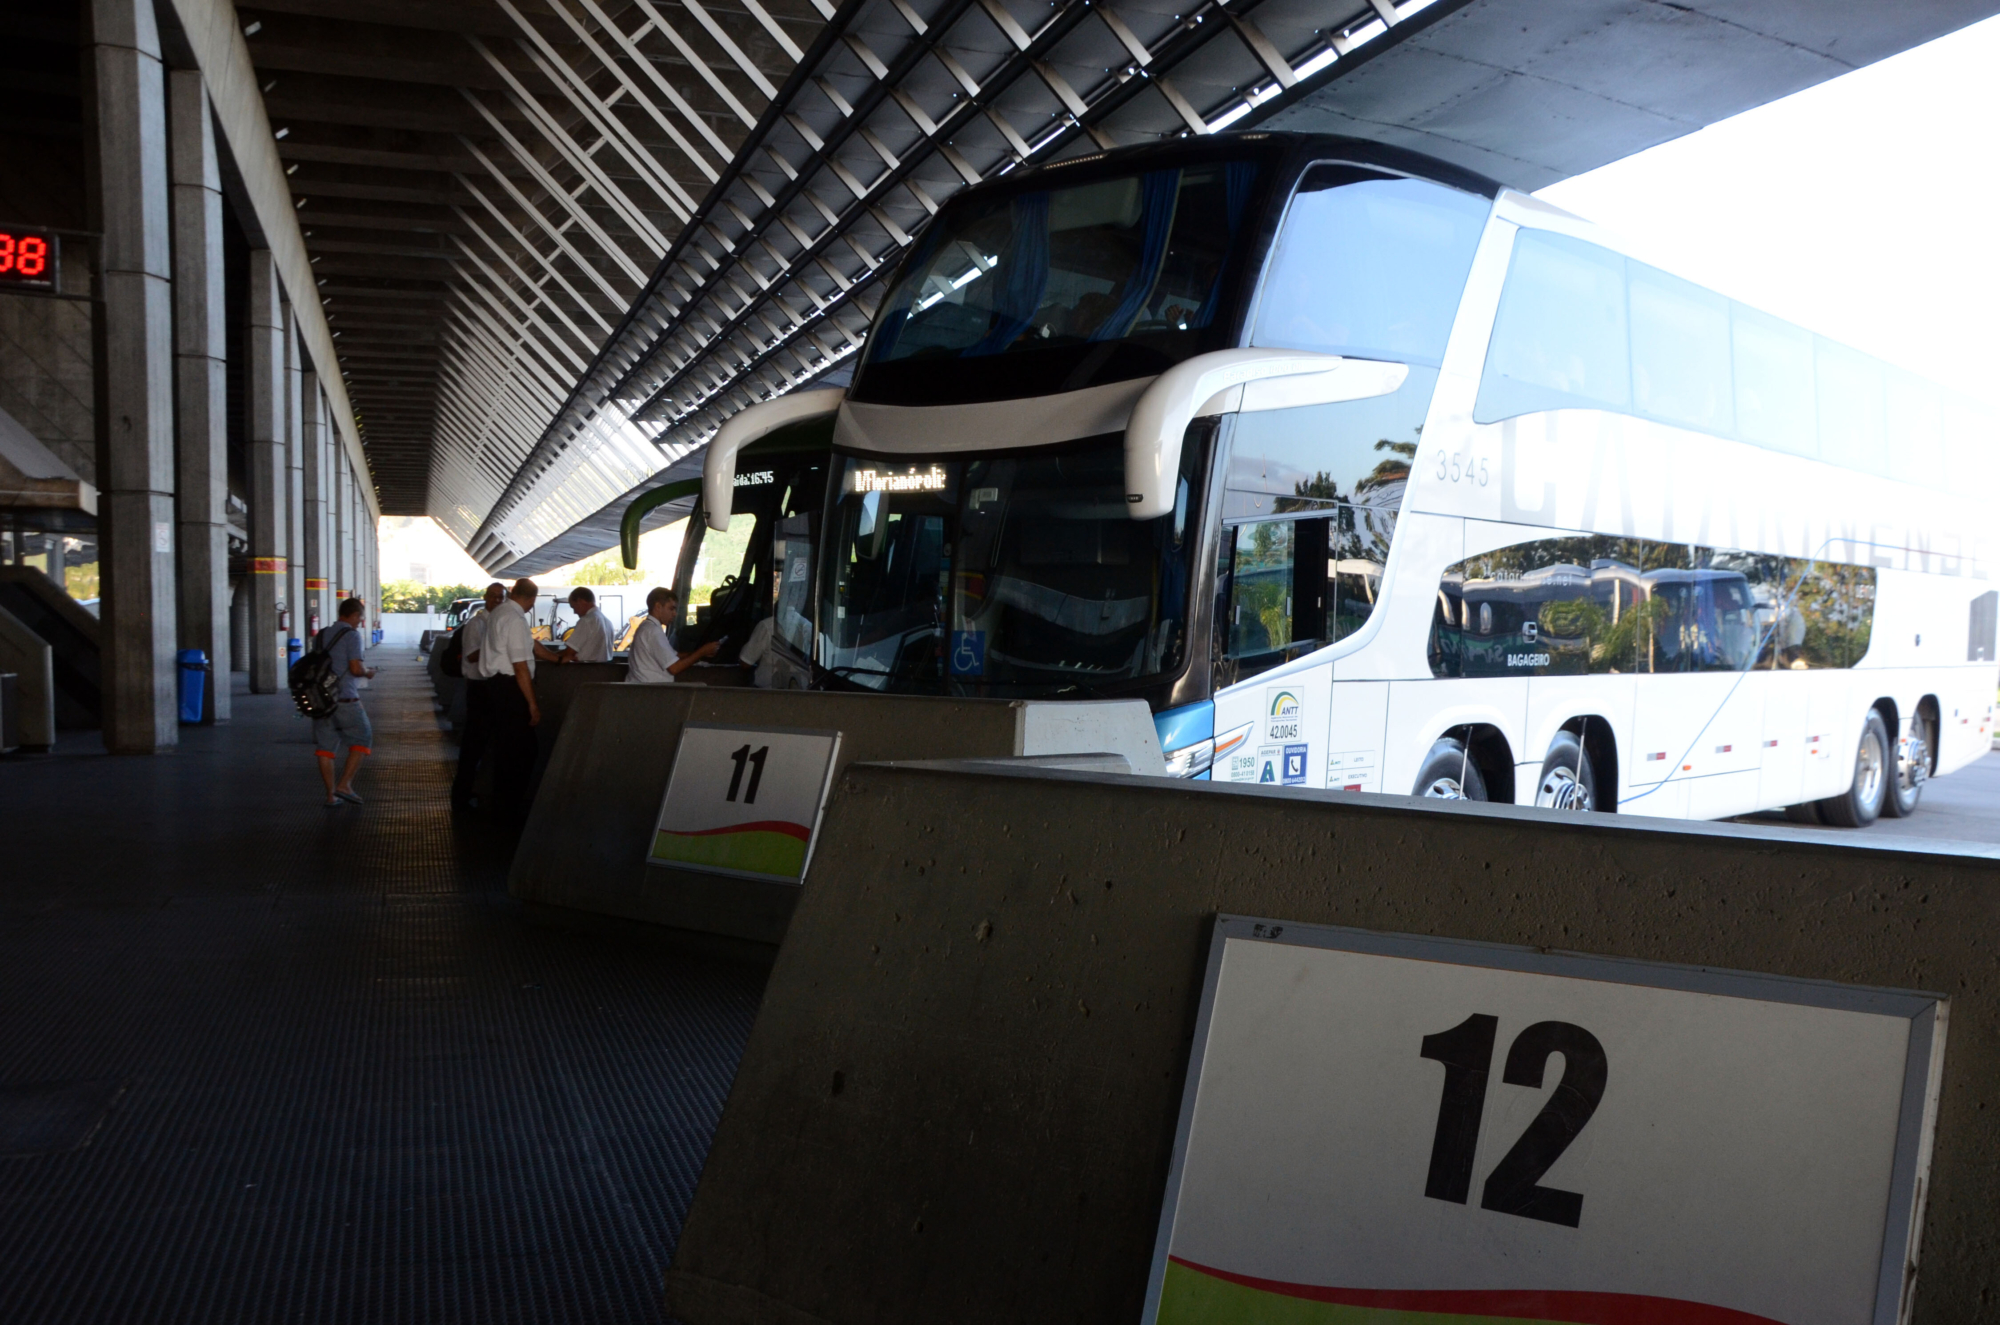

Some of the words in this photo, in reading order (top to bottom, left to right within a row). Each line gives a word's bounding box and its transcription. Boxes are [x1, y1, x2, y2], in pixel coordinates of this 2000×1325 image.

[1222, 366, 1267, 381] Paradiso
[1436, 449, 1489, 487] 3545
[1507, 653, 1550, 667] BAGAGEIRO
[1281, 706, 1299, 715] ANTT
[1269, 724, 1298, 739] 42.0045
[1286, 746, 1307, 754] OUVIDORIA
[1239, 756, 1255, 768] 1950
[726, 744, 769, 804] 11
[1420, 1012, 1608, 1229] 12
